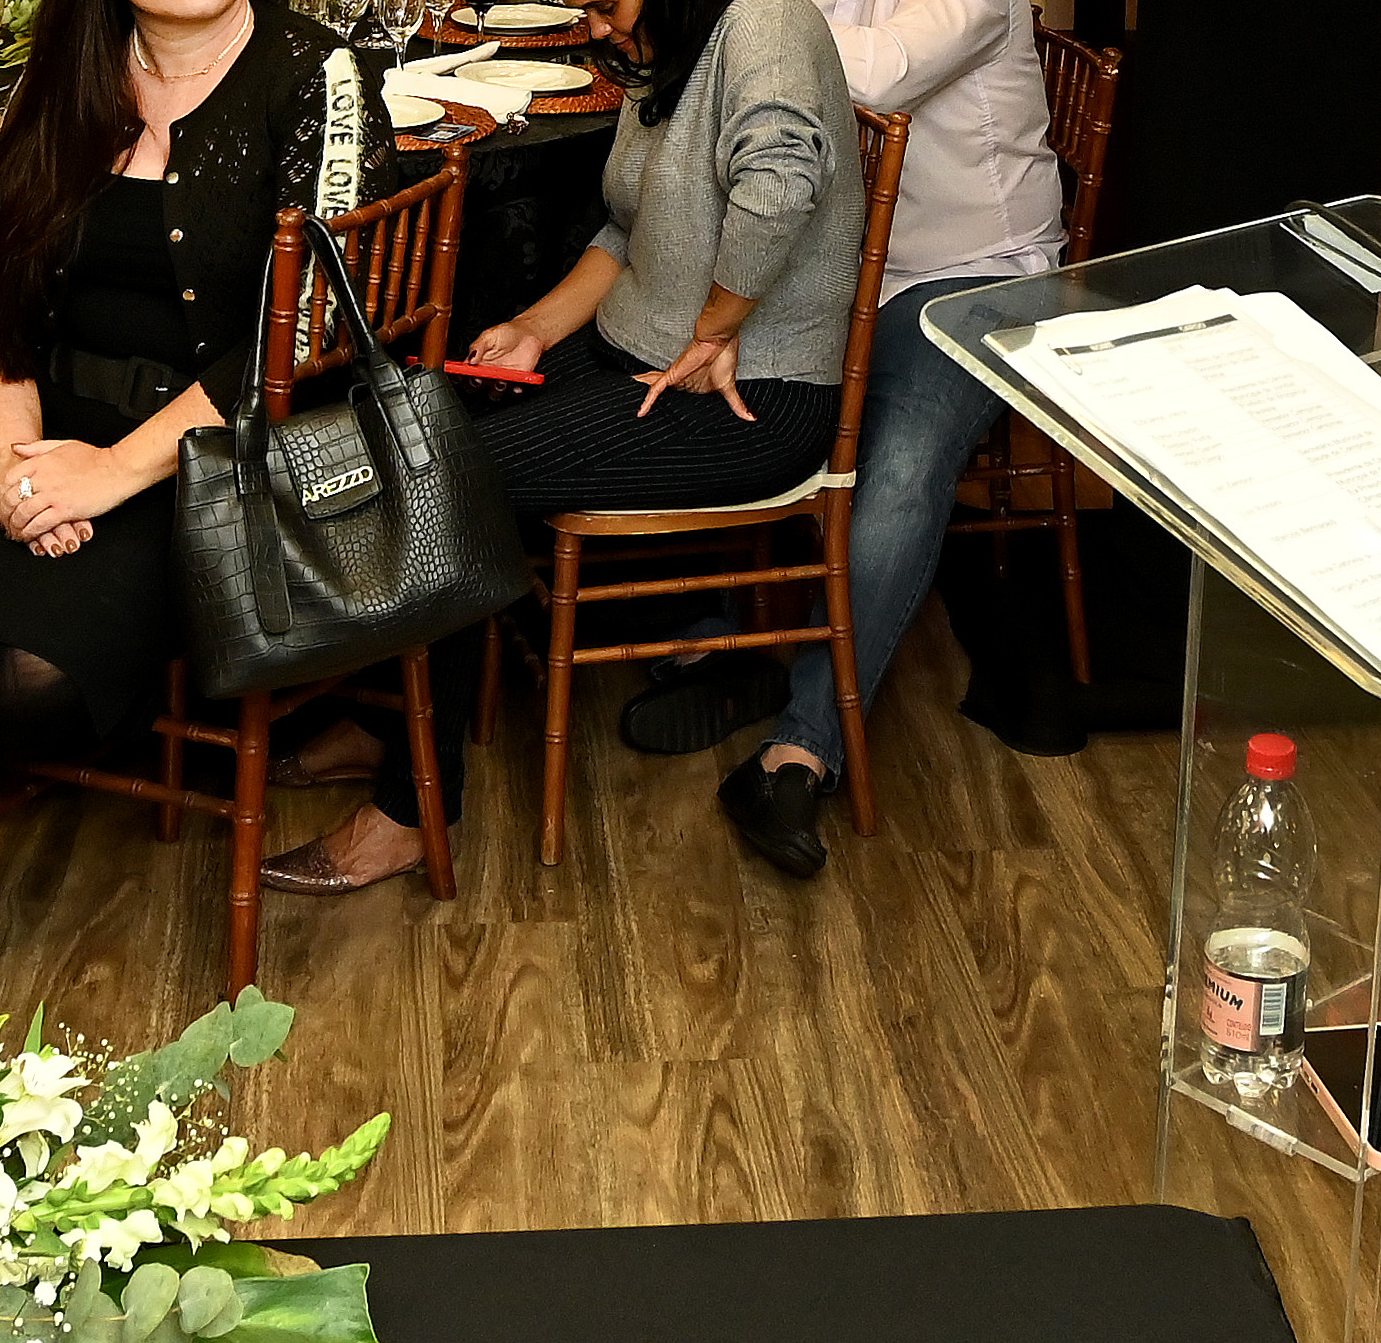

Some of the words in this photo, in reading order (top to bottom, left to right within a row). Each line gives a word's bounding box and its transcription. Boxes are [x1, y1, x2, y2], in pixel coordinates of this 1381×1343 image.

[329, 78, 355, 146] LOVE
[321, 159, 353, 219] LOVE
[302, 465, 374, 507] AREZZO
